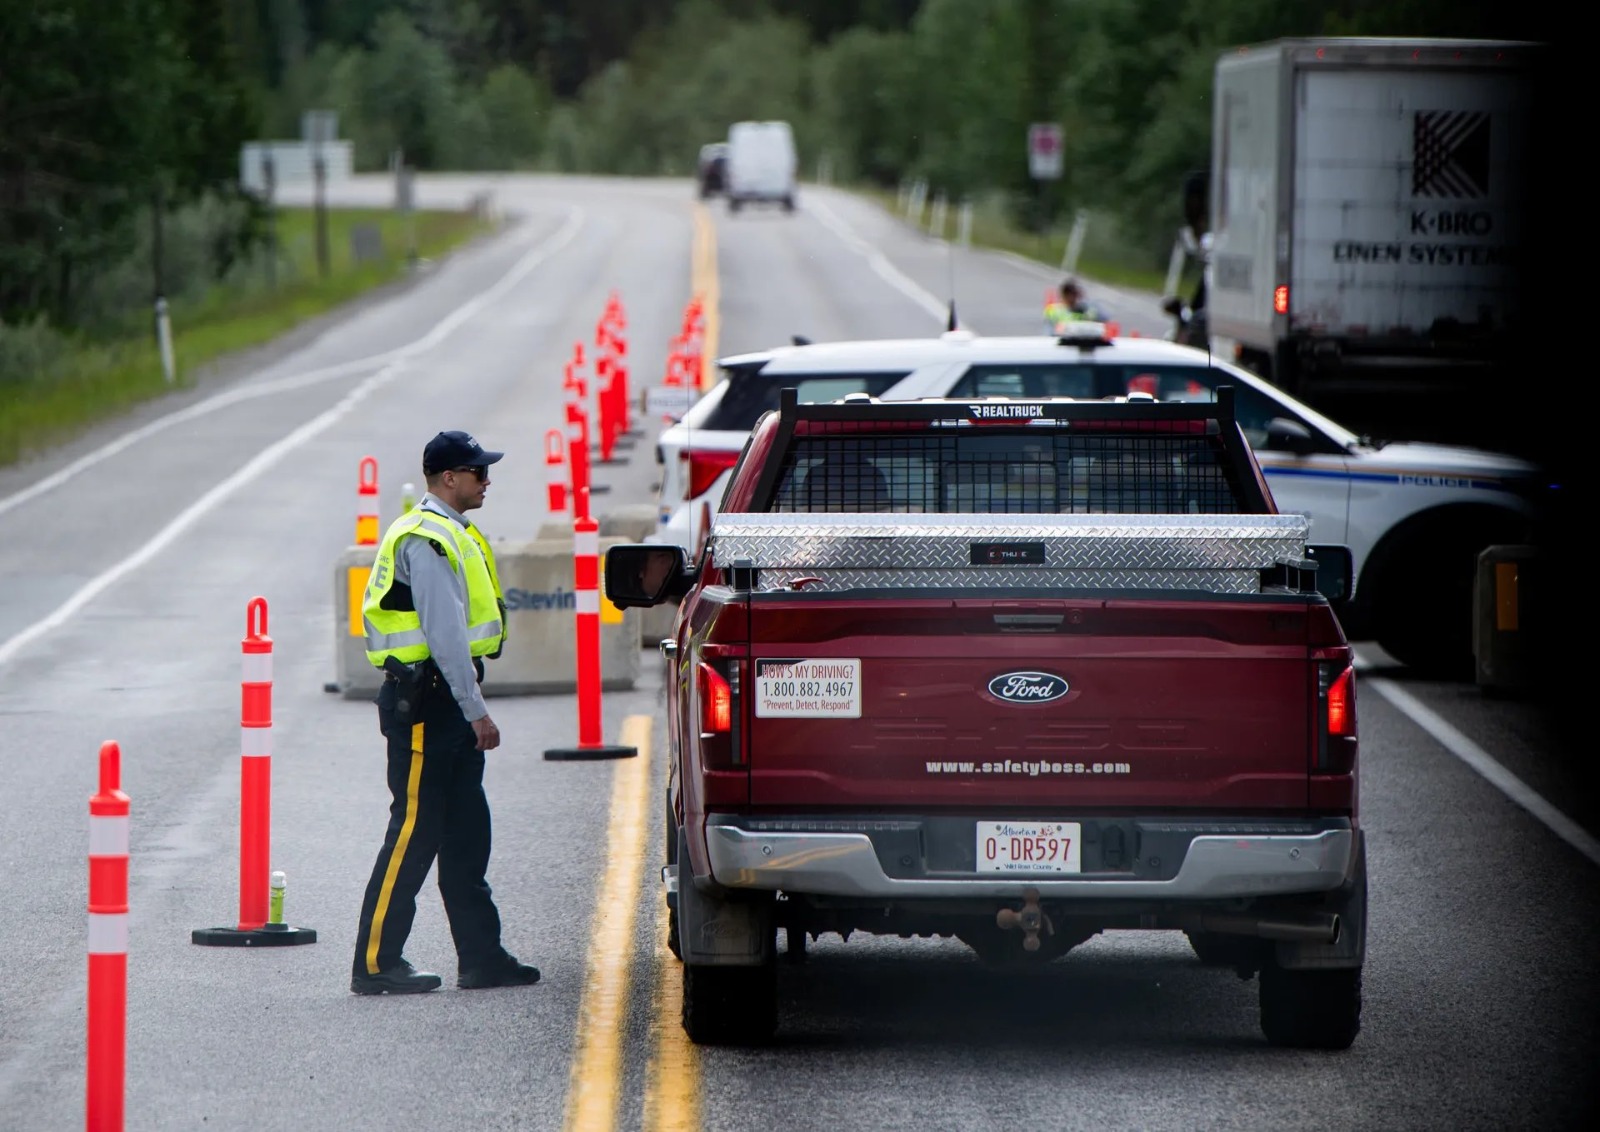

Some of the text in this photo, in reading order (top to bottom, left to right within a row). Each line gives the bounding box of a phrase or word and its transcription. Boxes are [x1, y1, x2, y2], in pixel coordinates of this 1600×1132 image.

[983, 405, 1044, 417] REALTRUCK
[1402, 475, 1470, 488] POLICE
[762, 663, 854, 679] HOW'S MY DRIVING?
[763, 681, 854, 697] 1.800.882.4967
[1002, 675, 1053, 698] Ford
[795, 700, 820, 711] Detect,
[926, 760, 1131, 776] www.safetyboss.com
